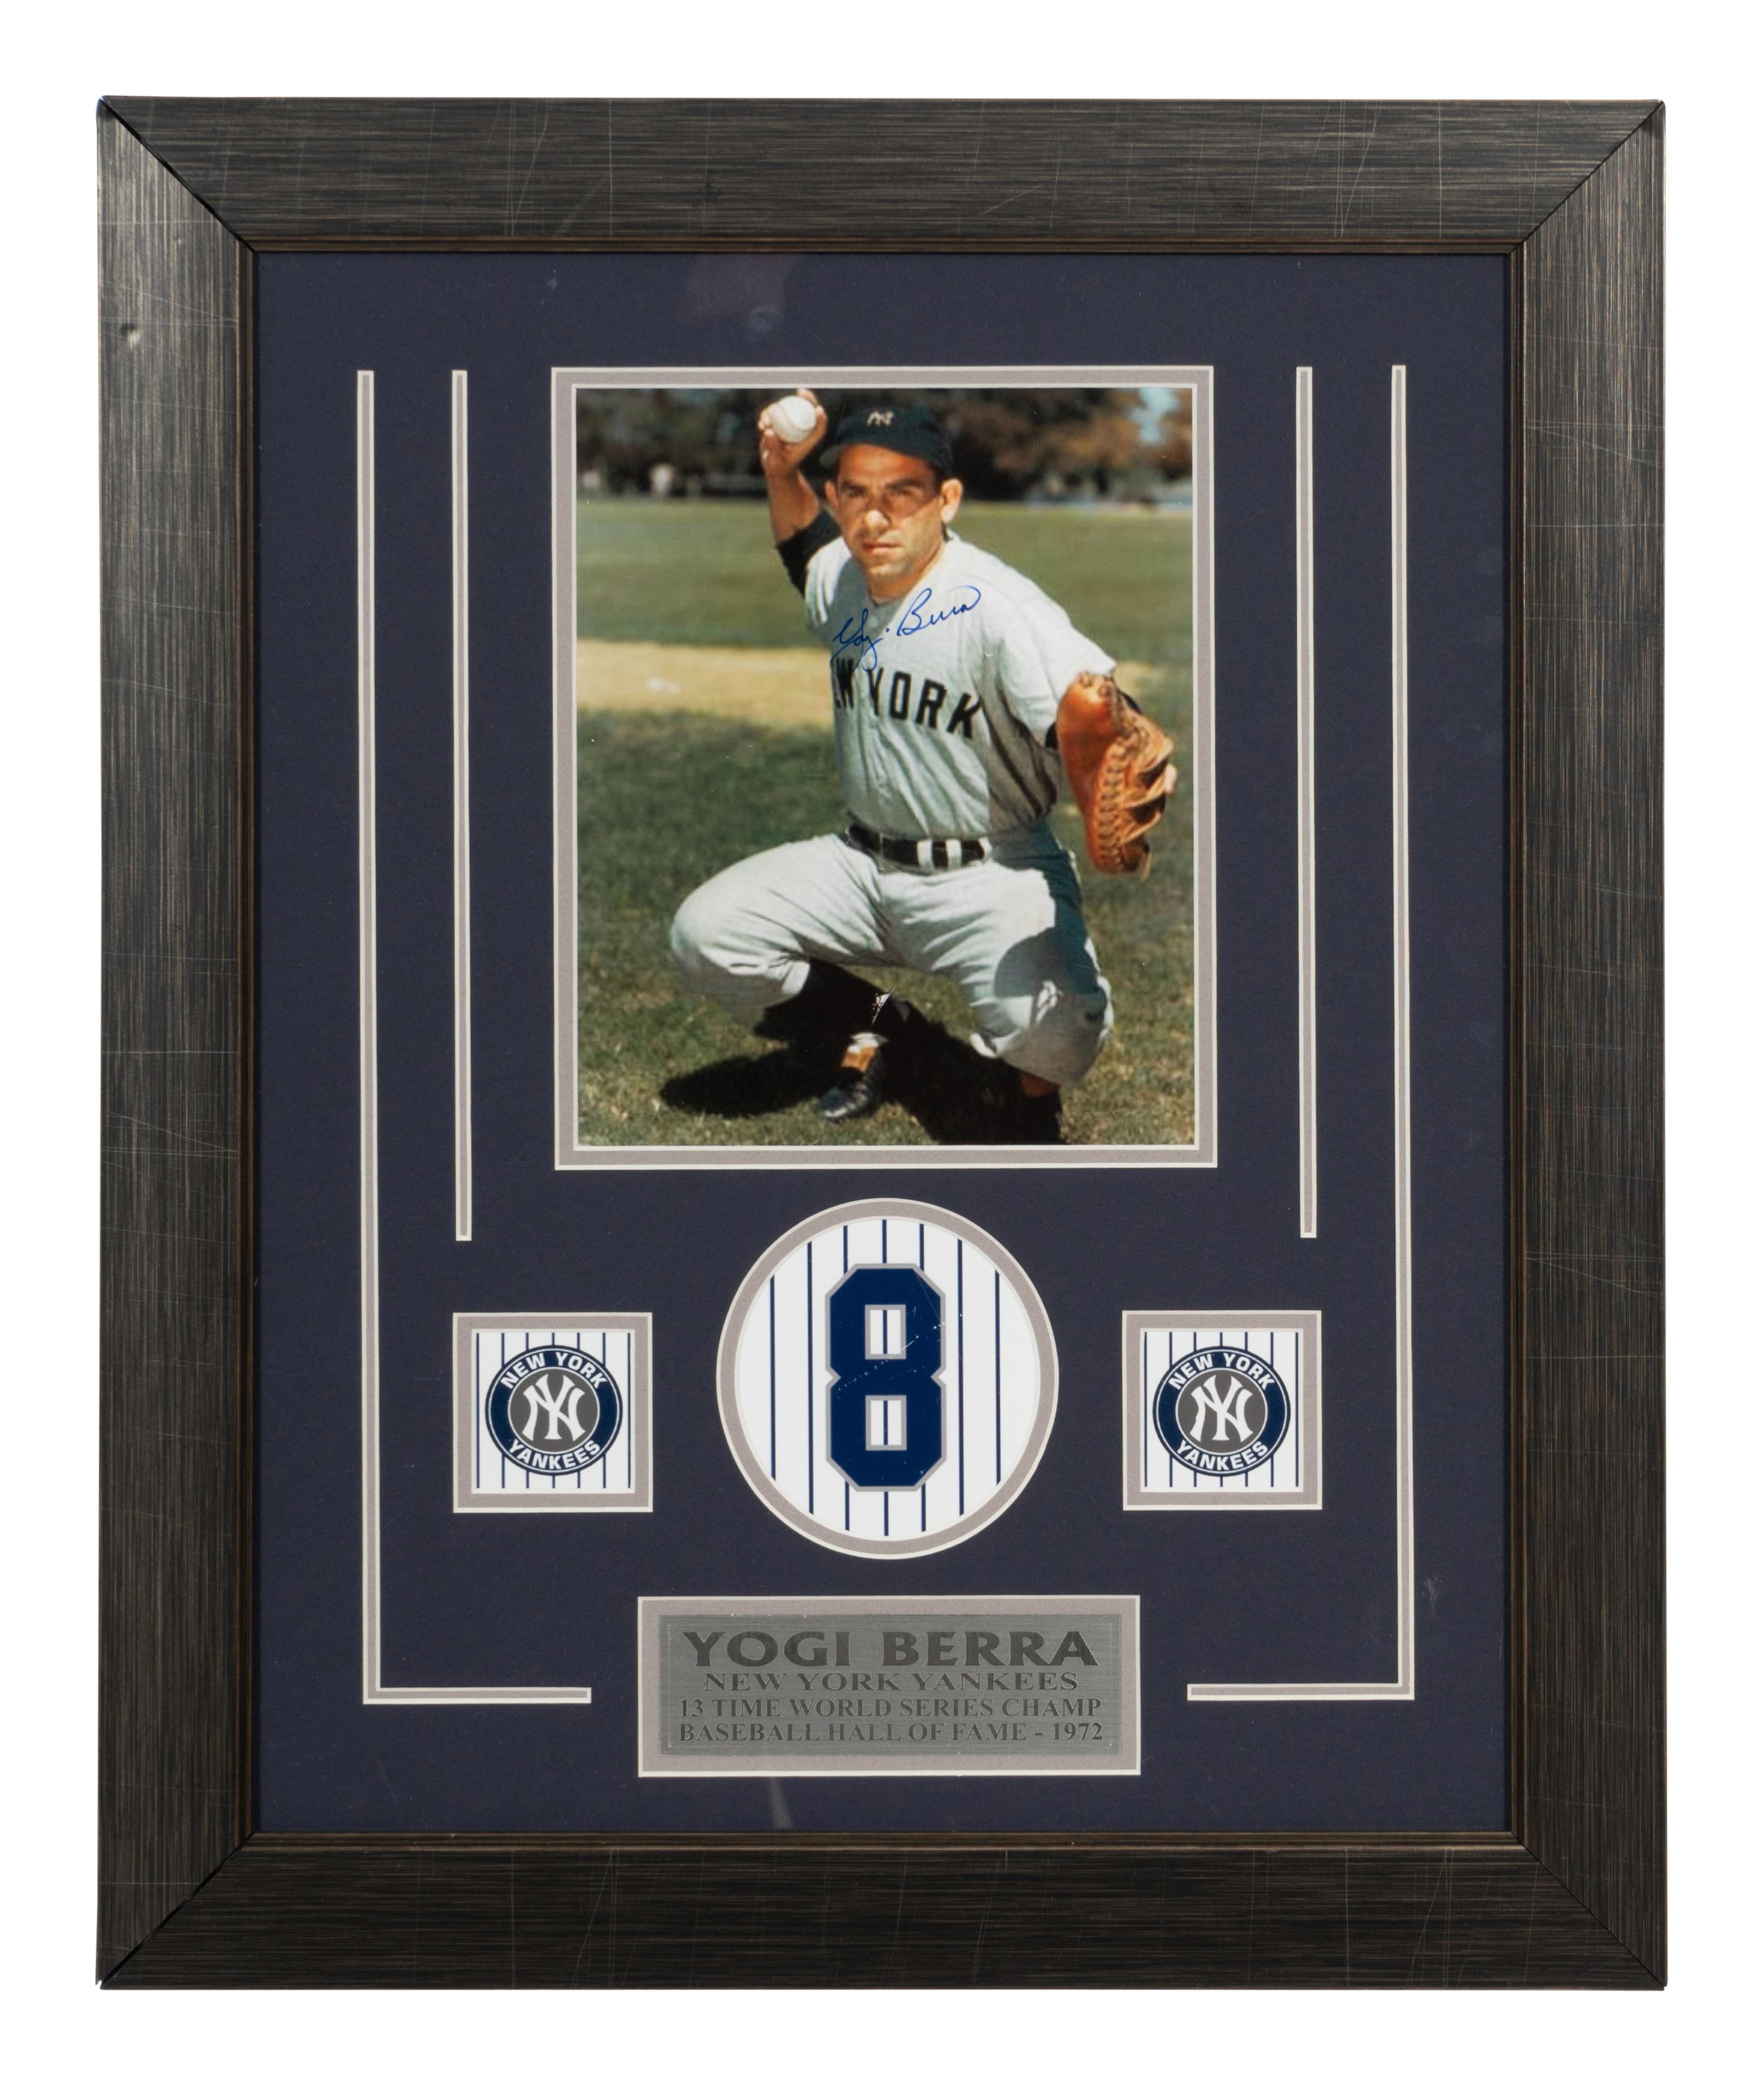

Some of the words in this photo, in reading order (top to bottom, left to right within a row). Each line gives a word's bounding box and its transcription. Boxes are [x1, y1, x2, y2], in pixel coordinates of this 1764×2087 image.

[867, 667, 981, 739] YORK
[500, 1353, 546, 1389] NEW
[555, 1351, 608, 1388] YORK
[825, 1263, 947, 1492] 8
[1168, 1354, 1213, 1390] NEW
[1222, 1353, 1276, 1390] YORK
[507, 1439, 600, 1470] YANKEES
[1177, 1440, 1268, 1471] YANKEES
[682, 1631, 850, 1667] YOGI
[883, 1631, 1100, 1666] BERRA
[704, 1672, 787, 1691] NEW
[796, 1672, 902, 1691] YORK
[912, 1672, 1078, 1691] YANKEES
[679, 1699, 704, 1717] 13
[711, 1699, 781, 1717] TIME
[789, 1699, 892, 1717] WORLD
[900, 1698, 994, 1717] SERIES
[1001, 1698, 1102, 1717] CHAMP
[679, 1722, 820, 1741] BASEBALL
[827, 1722, 901, 1741] HALL
[908, 1722, 943, 1741] OF
[951, 1722, 1027, 1741] FAME
[1052, 1722, 1103, 1741] 1972
